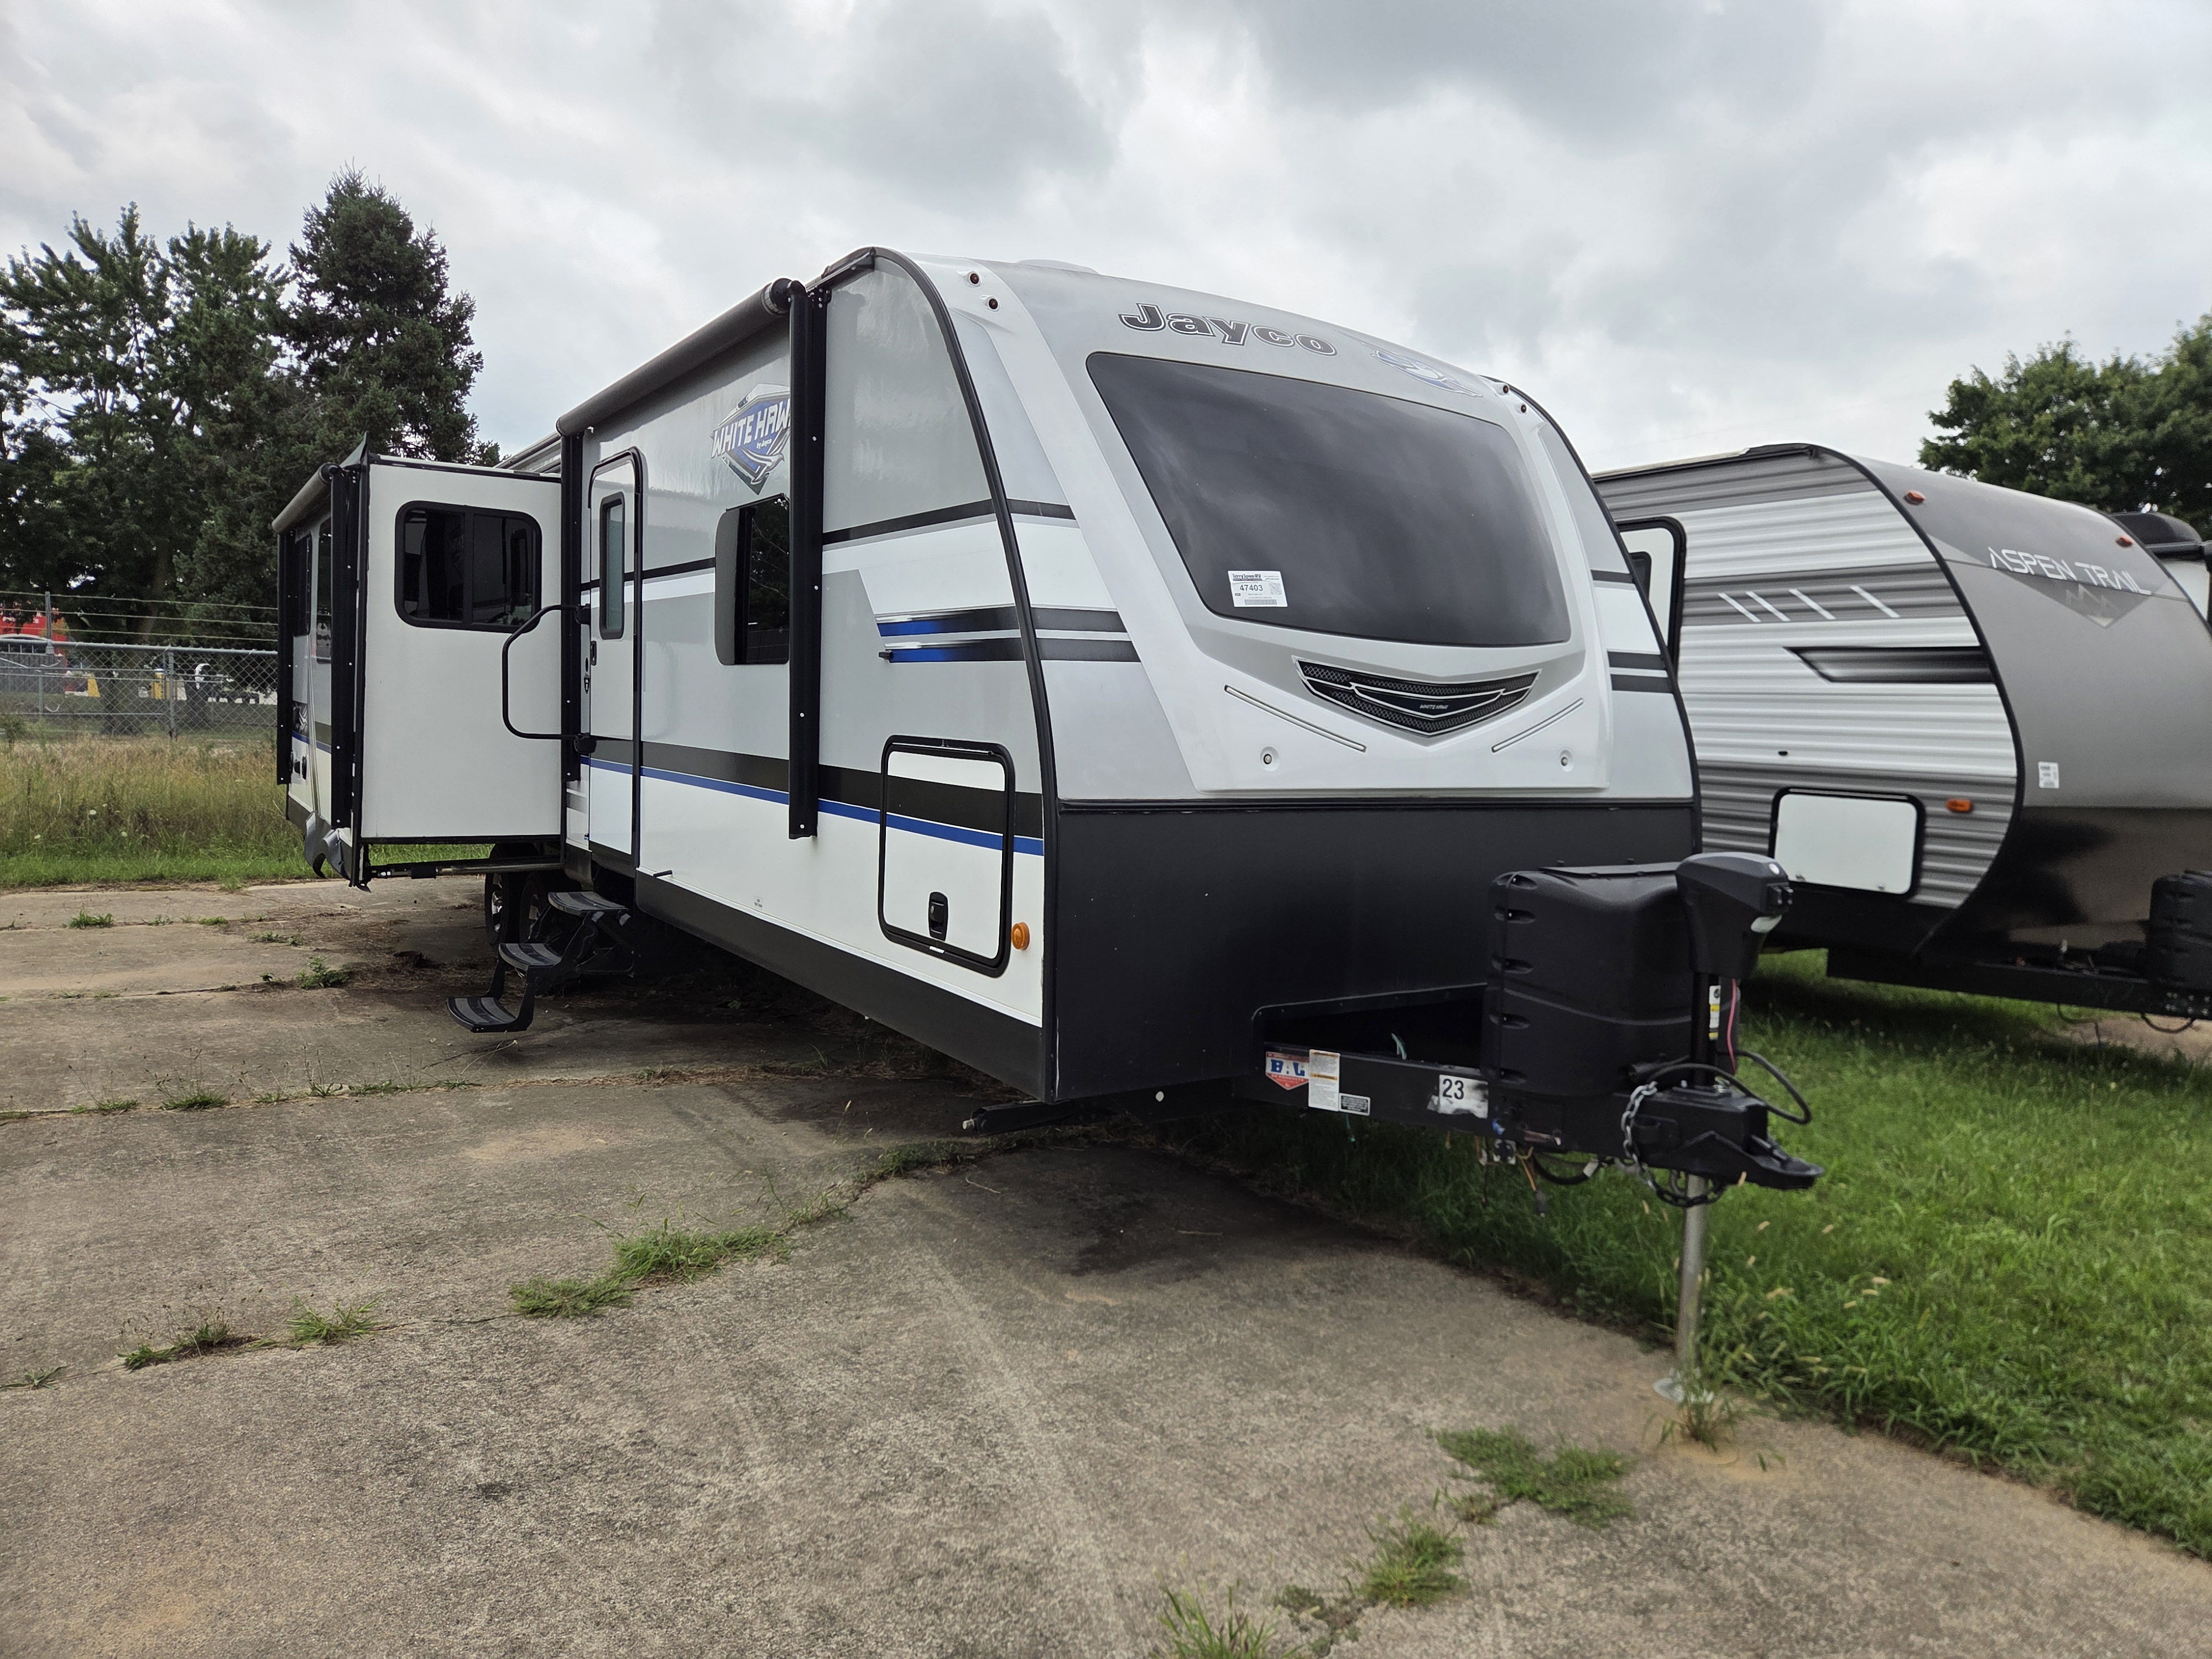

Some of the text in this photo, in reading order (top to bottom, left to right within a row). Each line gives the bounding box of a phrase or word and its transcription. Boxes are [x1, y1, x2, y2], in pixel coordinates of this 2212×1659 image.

[1118, 302, 1337, 357] Jayco
[711, 398, 790, 458] WHITE HAW
[1988, 546, 2152, 596] ASPEN TRAIL
[1271, 1059, 1305, 1077] BAL
[1442, 1078, 1464, 1100] 23
